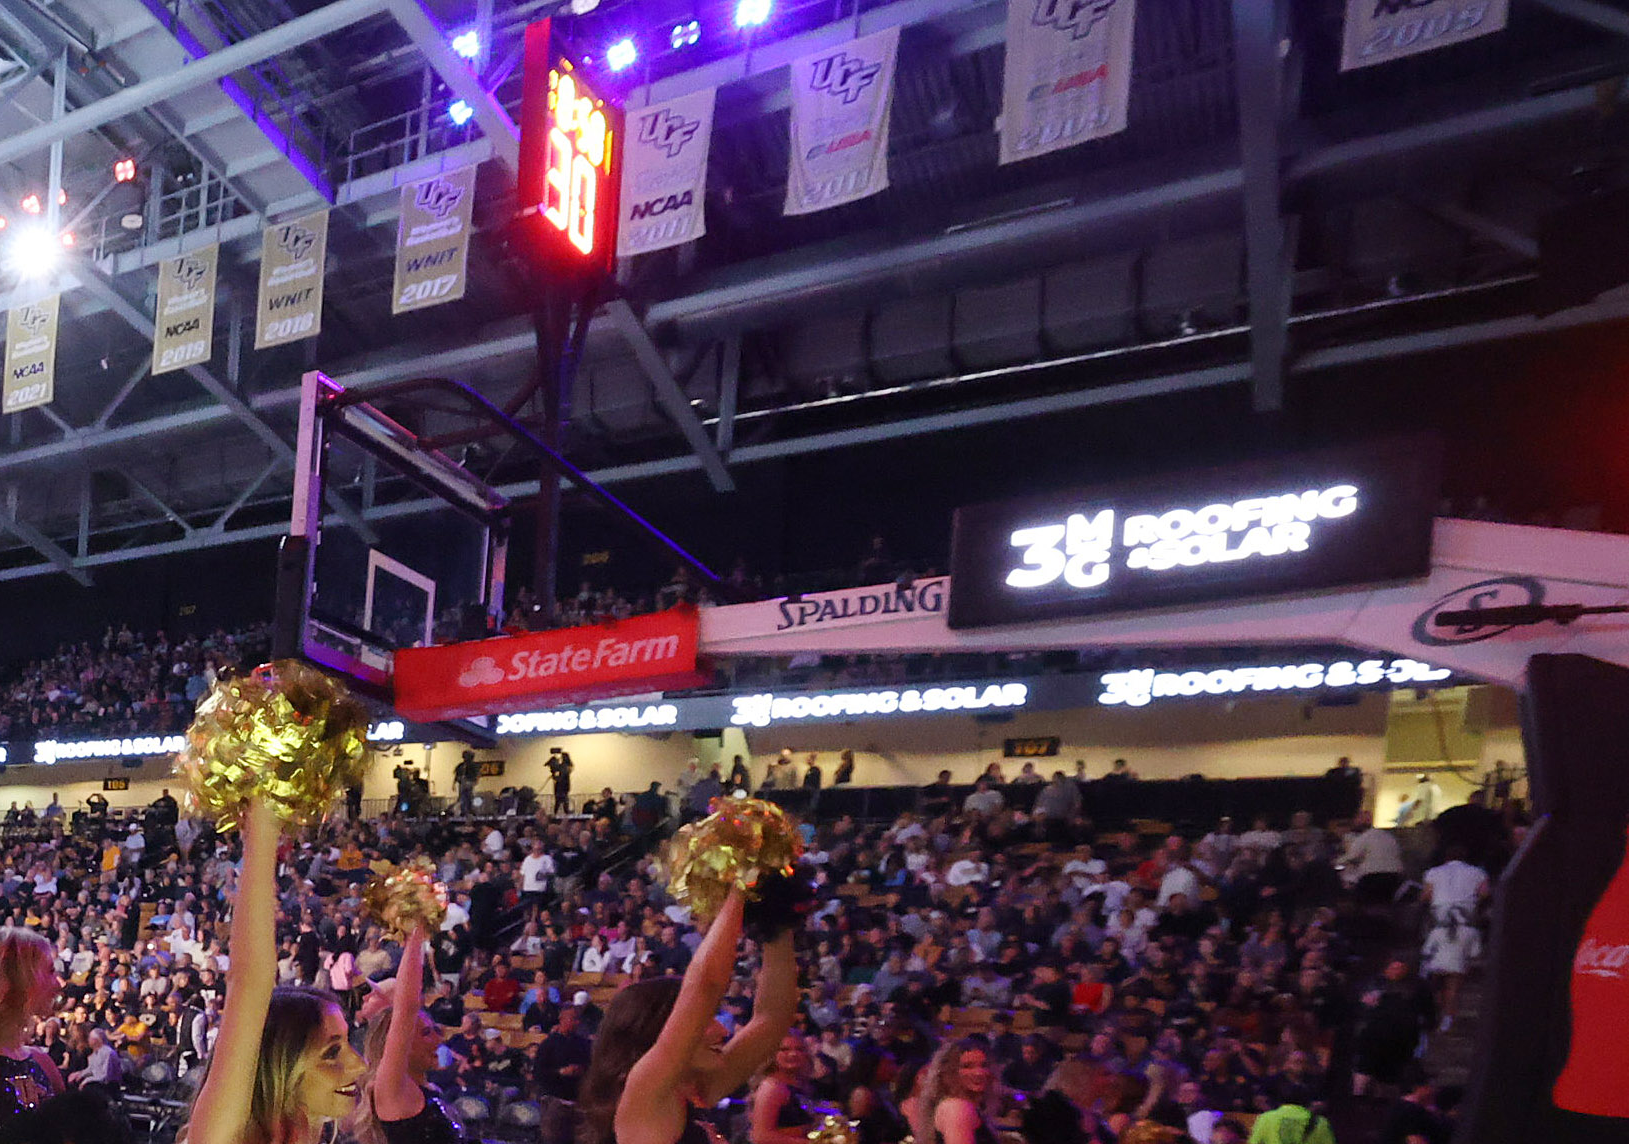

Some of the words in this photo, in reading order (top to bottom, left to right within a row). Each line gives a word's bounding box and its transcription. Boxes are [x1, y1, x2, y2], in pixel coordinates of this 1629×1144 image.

[809, 52, 881, 105] UCF
[638, 108, 700, 158] UCF
[414, 179, 464, 219] UCF
[630, 189, 694, 221] NCAA
[278, 223, 317, 260] UCF
[173, 257, 208, 294] UCF
[405, 248, 458, 274] WNIT
[267, 287, 314, 312] WNIT
[398, 274, 458, 305] 2017
[163, 318, 201, 340] NCAA
[12, 361, 46, 381] NCAA
[7, 384, 46, 407] 2021
[1123, 484, 1359, 547] ROOFING
[777, 580, 944, 631] SPALDING
[1152, 663, 1325, 697] ROOFING
[596, 704, 678, 728] SOLAR
[772, 690, 899, 719] ROOFING
[922, 682, 1028, 711] SOLAR
